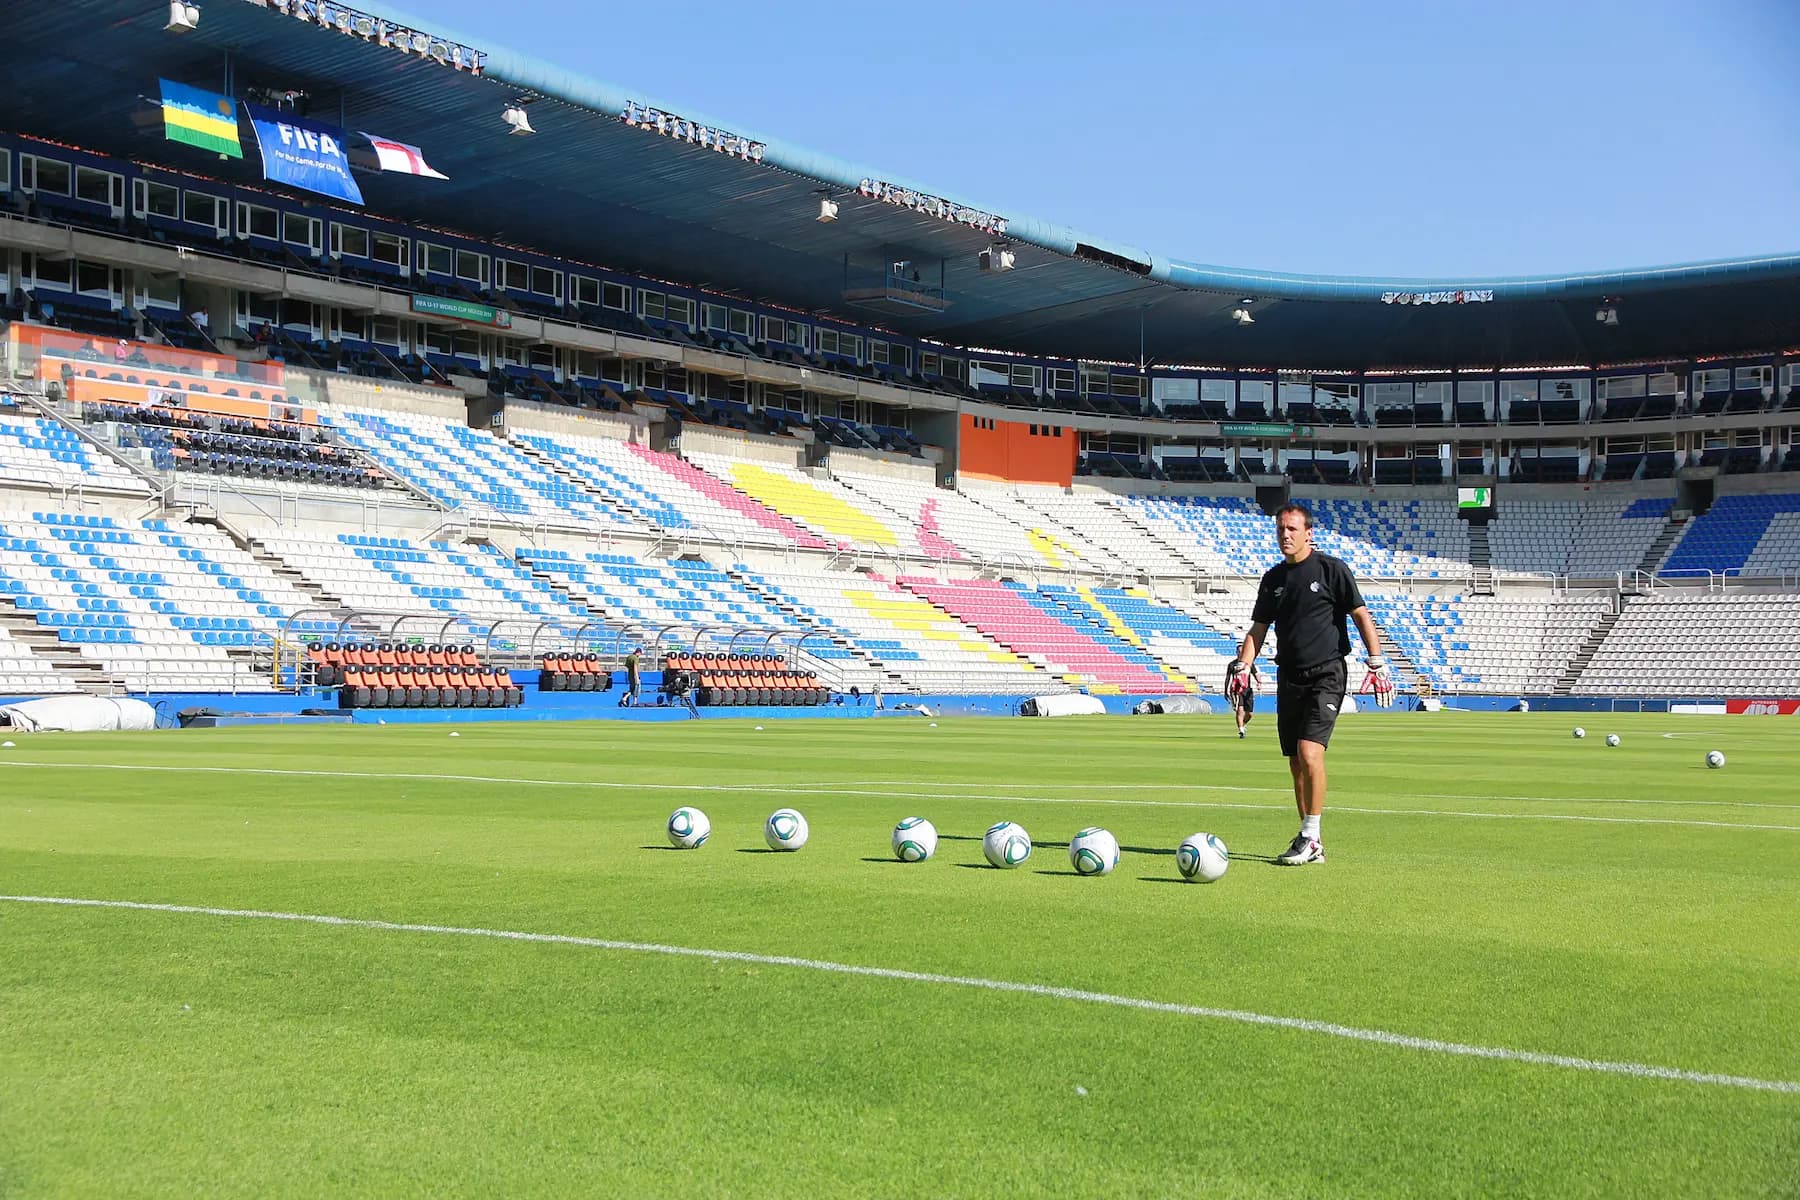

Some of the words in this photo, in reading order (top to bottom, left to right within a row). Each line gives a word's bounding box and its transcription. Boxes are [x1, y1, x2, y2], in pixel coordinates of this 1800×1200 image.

[277, 121, 340, 159] FIFA
[275, 150, 285, 158] For
[285, 153, 295, 162] the
[316, 161, 326, 169] For
[415, 299, 426, 307] FIFA
[1742, 704, 1780, 714] ADO
